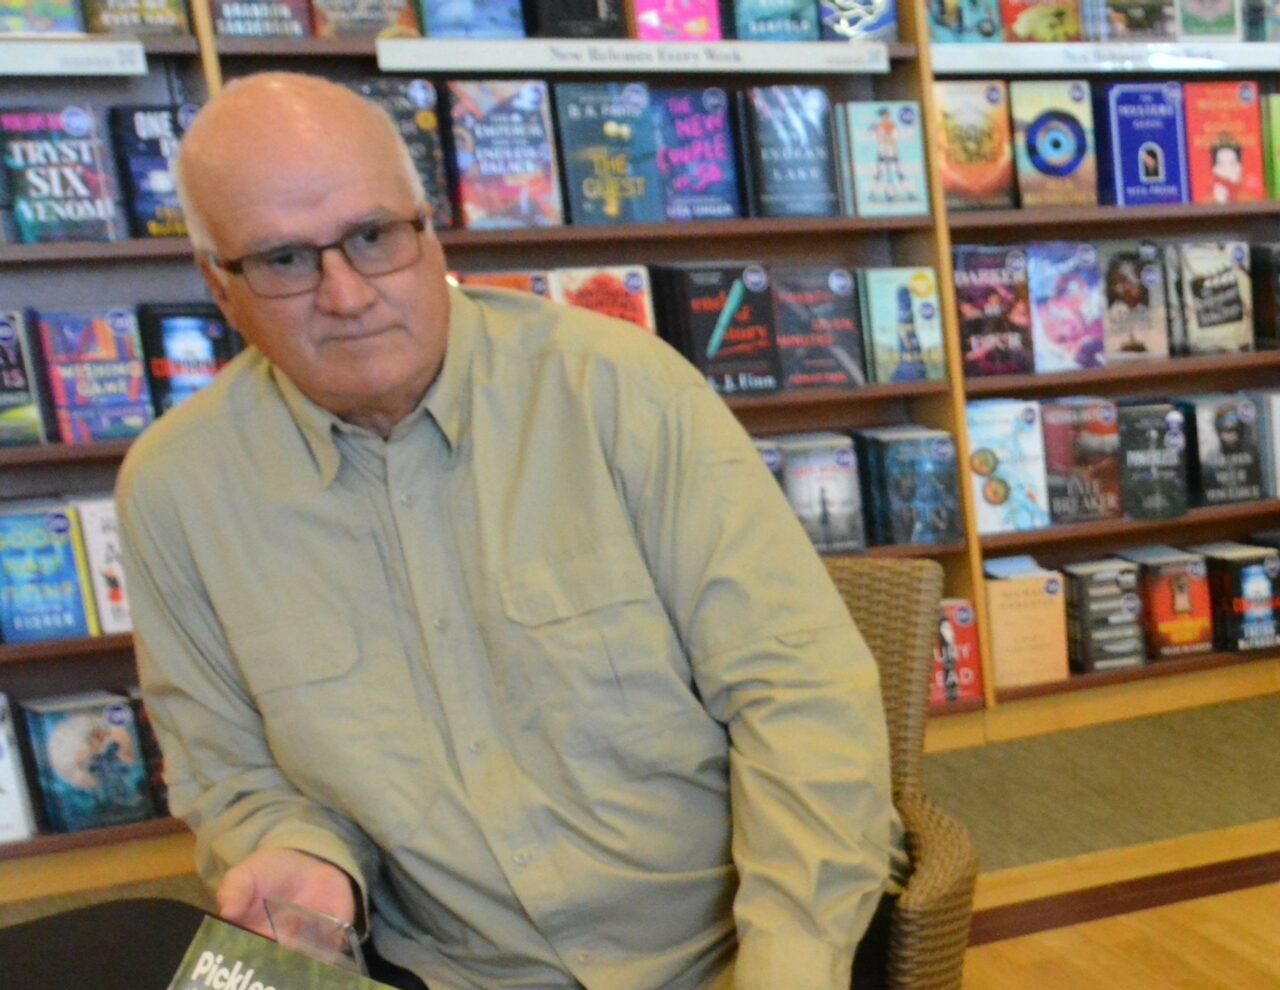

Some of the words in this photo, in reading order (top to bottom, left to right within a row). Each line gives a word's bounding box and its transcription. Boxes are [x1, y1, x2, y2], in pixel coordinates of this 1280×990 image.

[675, 112, 725, 138] NEW
[656, 134, 726, 174] COUPLE
[591, 155, 628, 176] THE
[772, 168, 820, 180] LAKE
[25, 166, 92, 198] SIX
[582, 176, 646, 199] GUEST
[954, 267, 1024, 286] DARKER
[738, 374, 778, 389] Finn
